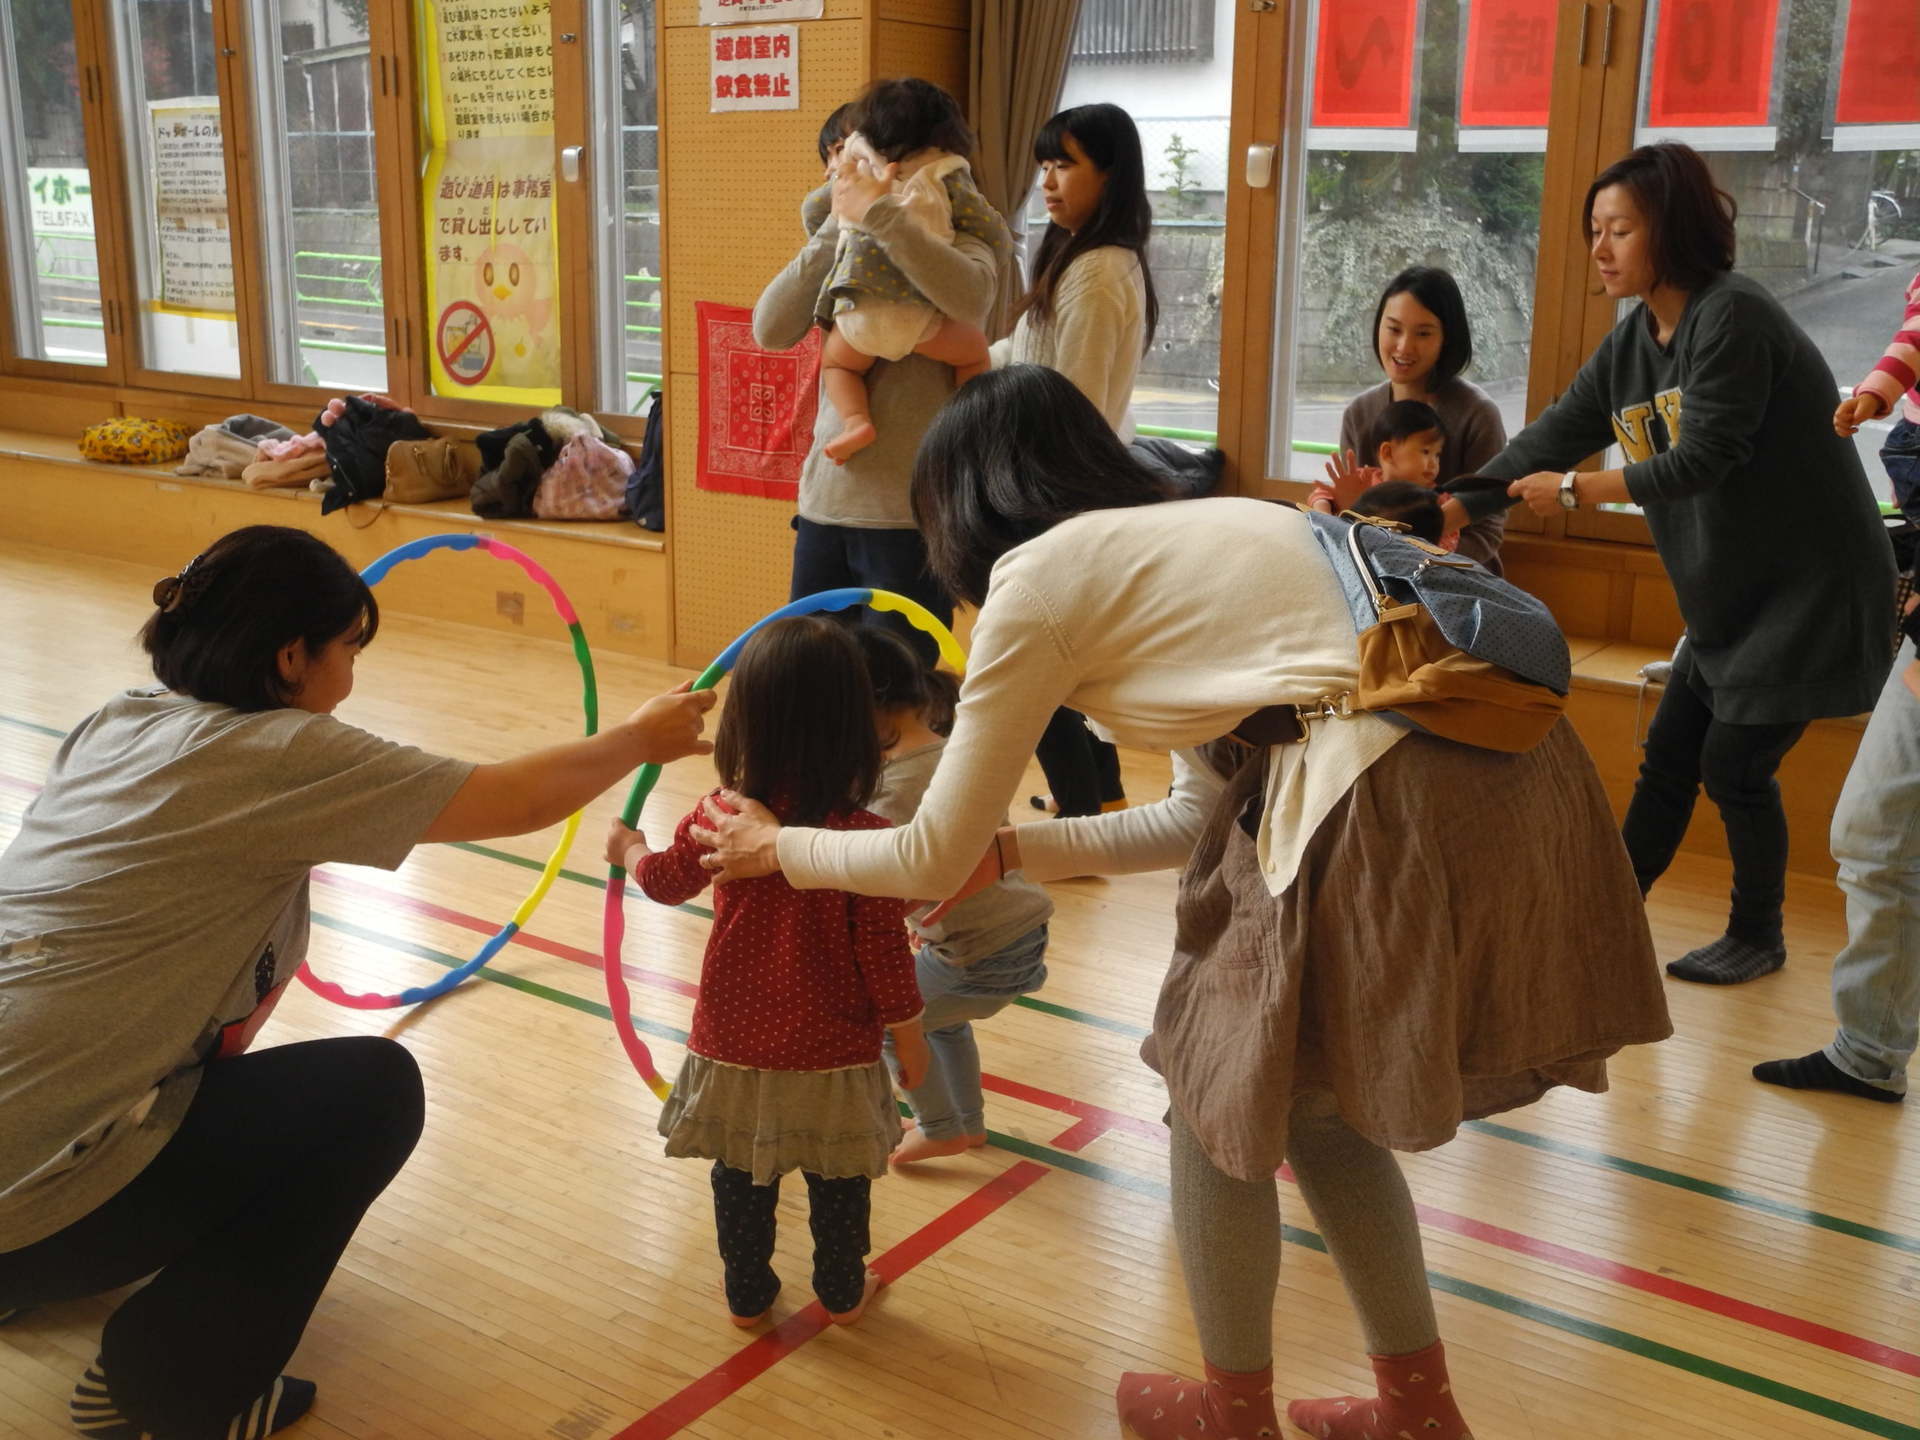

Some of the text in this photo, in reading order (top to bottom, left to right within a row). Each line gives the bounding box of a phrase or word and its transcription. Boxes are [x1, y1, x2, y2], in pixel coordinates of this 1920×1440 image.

[716, 34, 790, 61] 遊戯室内
[715, 73, 791, 98] 飲食禁止
[440, 179, 552, 199] 遊び道具は事務室
[440, 217, 547, 235] で貸し出ししてい
[439, 245, 469, 262] ます。
